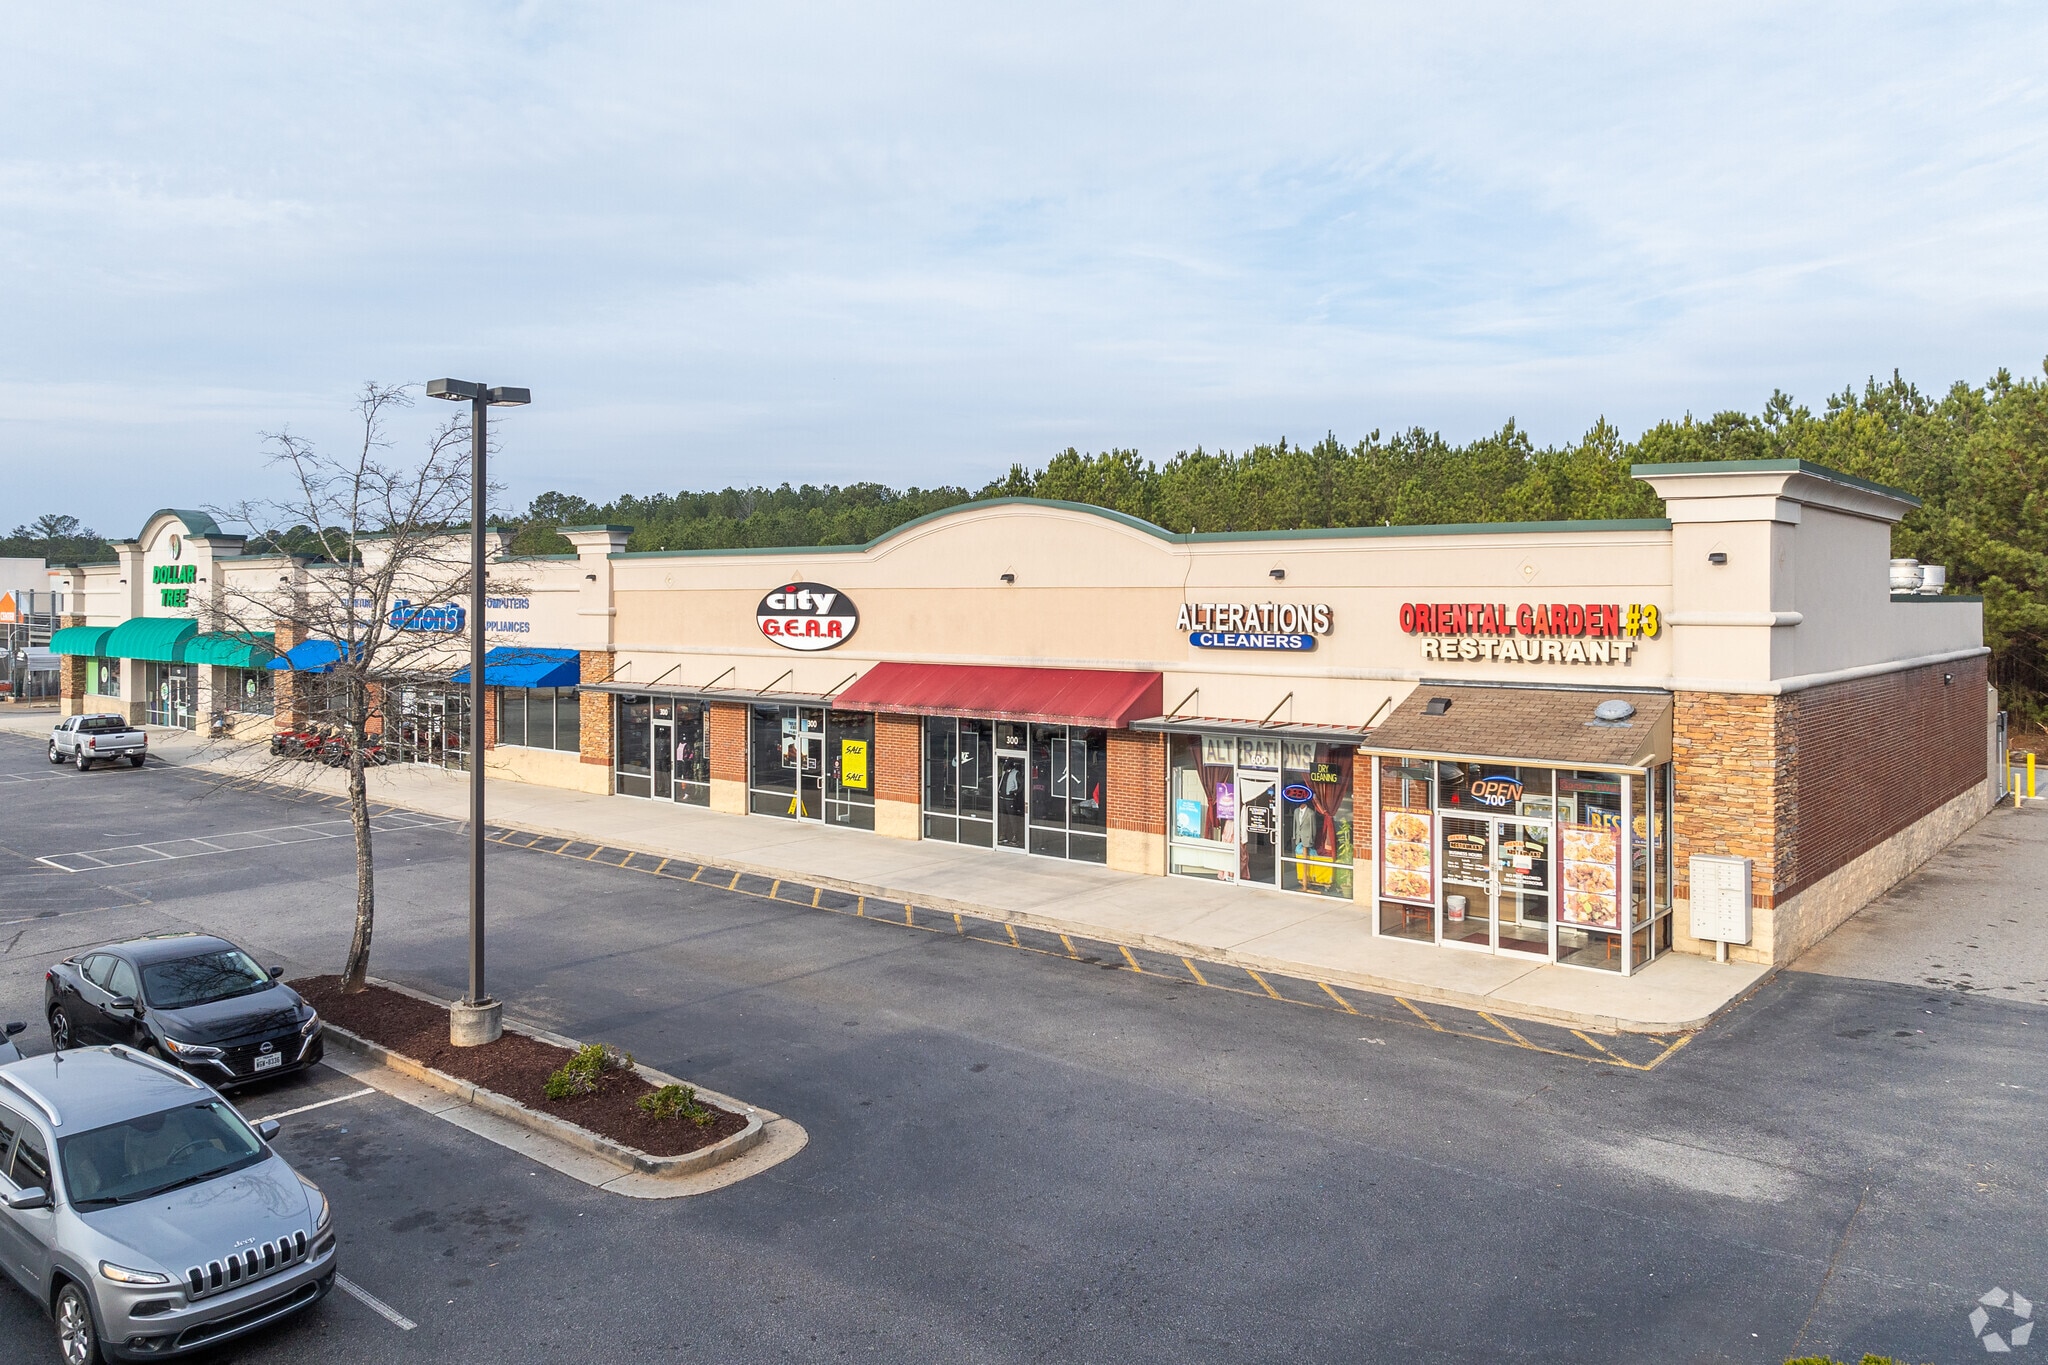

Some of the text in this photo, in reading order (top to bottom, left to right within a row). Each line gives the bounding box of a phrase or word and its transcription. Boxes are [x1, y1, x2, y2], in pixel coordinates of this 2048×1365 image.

[153, 565, 196, 584] DOLLAR
[160, 588, 188, 607] TREE
[485, 597, 530, 609] OMPUTERS
[766, 585, 838, 615] city
[390, 600, 460, 632] Aaron's
[1175, 603, 1330, 634] ALTERATIONS
[1399, 602, 1659, 637] ORIENTAL GARDEN #3
[485, 620, 530, 633] PPLIANCES
[1199, 633, 1302, 649] CLEANERS
[1420, 638, 1635, 663] RESTAURANT
[1006, 736, 1019, 745] 300
[845, 746, 864, 755] SALE
[1251, 755, 1268, 765] 600
[1317, 764, 1329, 773] DRY
[845, 772, 864, 782] SALE
[1310, 772, 1338, 783] CLEANING
[1470, 780, 1523, 801] OPEN
[1484, 794, 1506, 807] 700
[234, 1236, 256, 1248] Jeep
